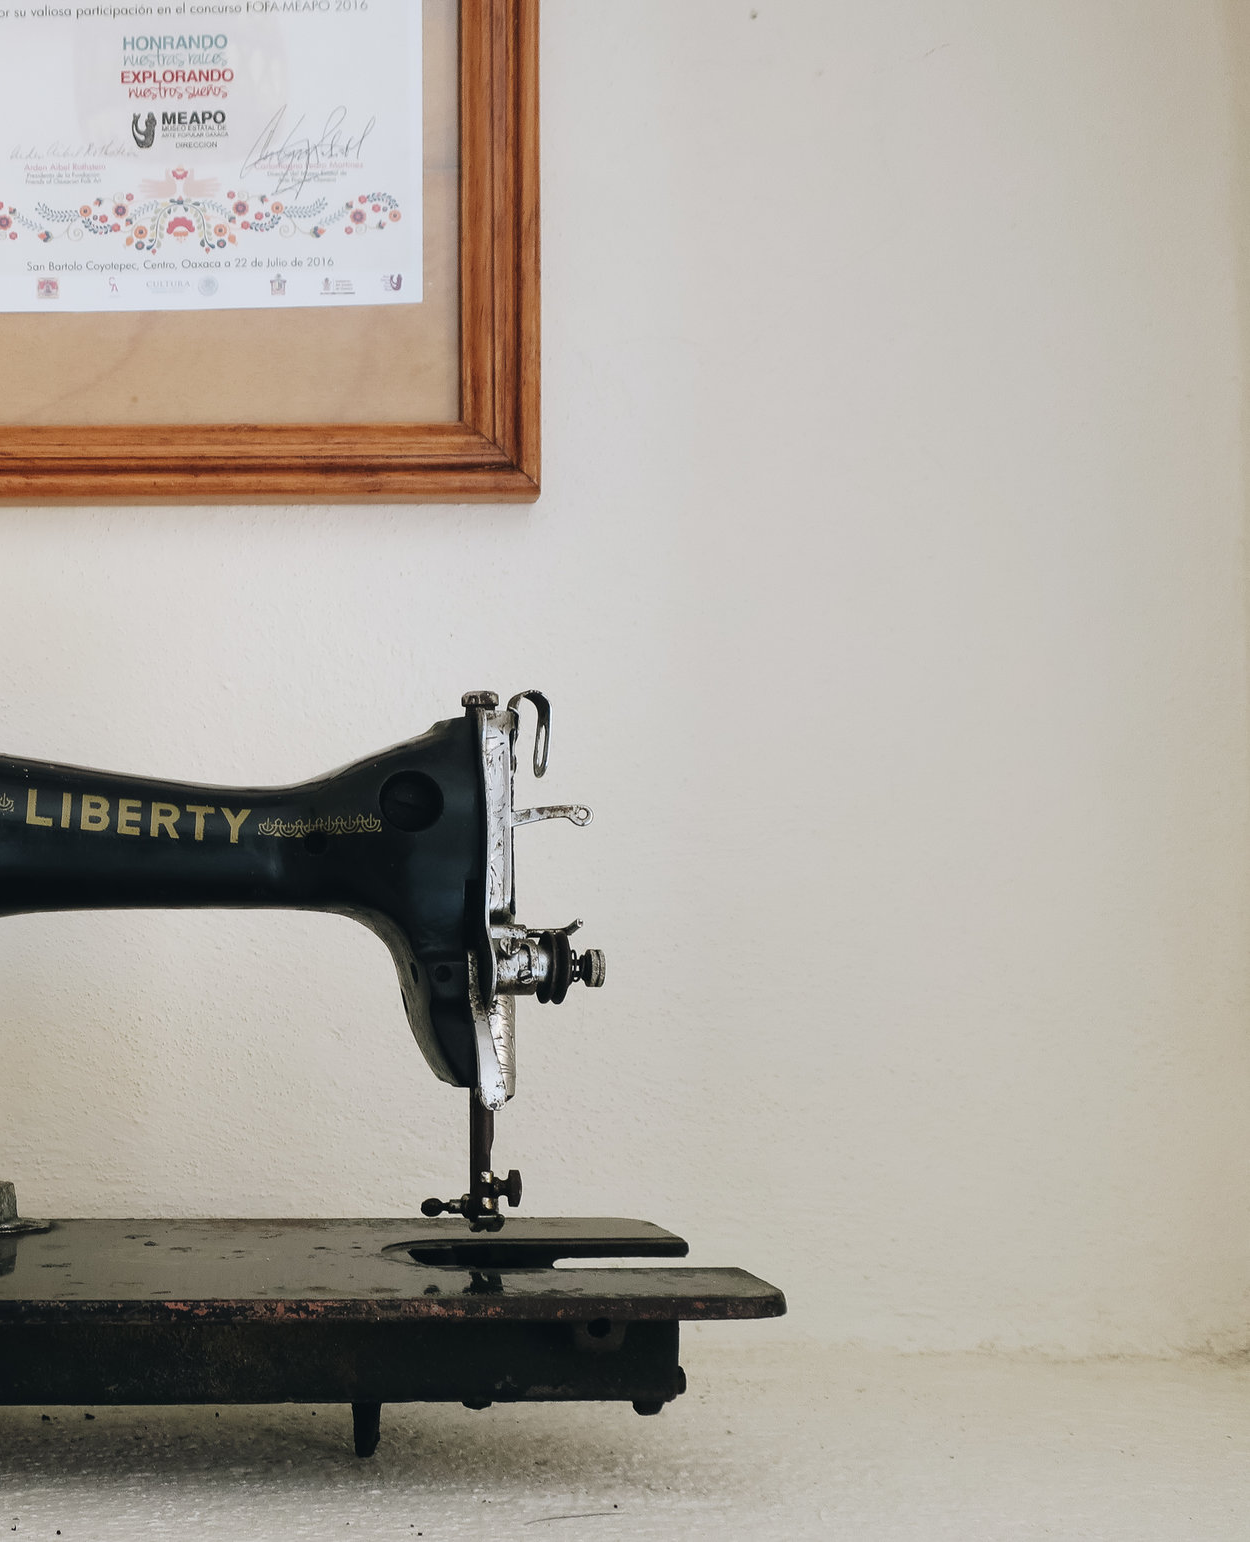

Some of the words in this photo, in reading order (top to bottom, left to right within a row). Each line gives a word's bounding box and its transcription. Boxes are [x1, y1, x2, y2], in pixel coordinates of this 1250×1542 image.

[14, 9, 27, 17] su
[30, 5, 72, 17] valiosa
[76, 5, 153, 19] participación
[156, 6, 172, 15] en
[175, 3, 186, 15] el
[189, 5, 242, 14] concurso
[335, 0, 369, 12] 2016
[122, 34, 229, 51] HONRANDO
[123, 48, 185, 67] nuestras
[120, 68, 235, 84] EXPLORANDO
[128, 81, 183, 100] nuestros
[185, 84, 228, 100] sueños
[161, 110, 227, 125] MEAPO
[161, 124, 187, 132] MUSEO
[26, 260, 45, 271] San
[48, 260, 83, 271] Bartolo
[85, 260, 140, 273] Coyotepec,
[143, 259, 178, 271] Centro,
[181, 258, 221, 269] Oaxaca
[234, 258, 248, 268] 22
[251, 257, 264, 268] de
[266, 256, 288, 268] Julio
[290, 257, 303, 268] de
[307, 257, 335, 267] 2016
[144, 280, 191, 288] CULTURA
[25, 788, 252, 844] LIBERTY
